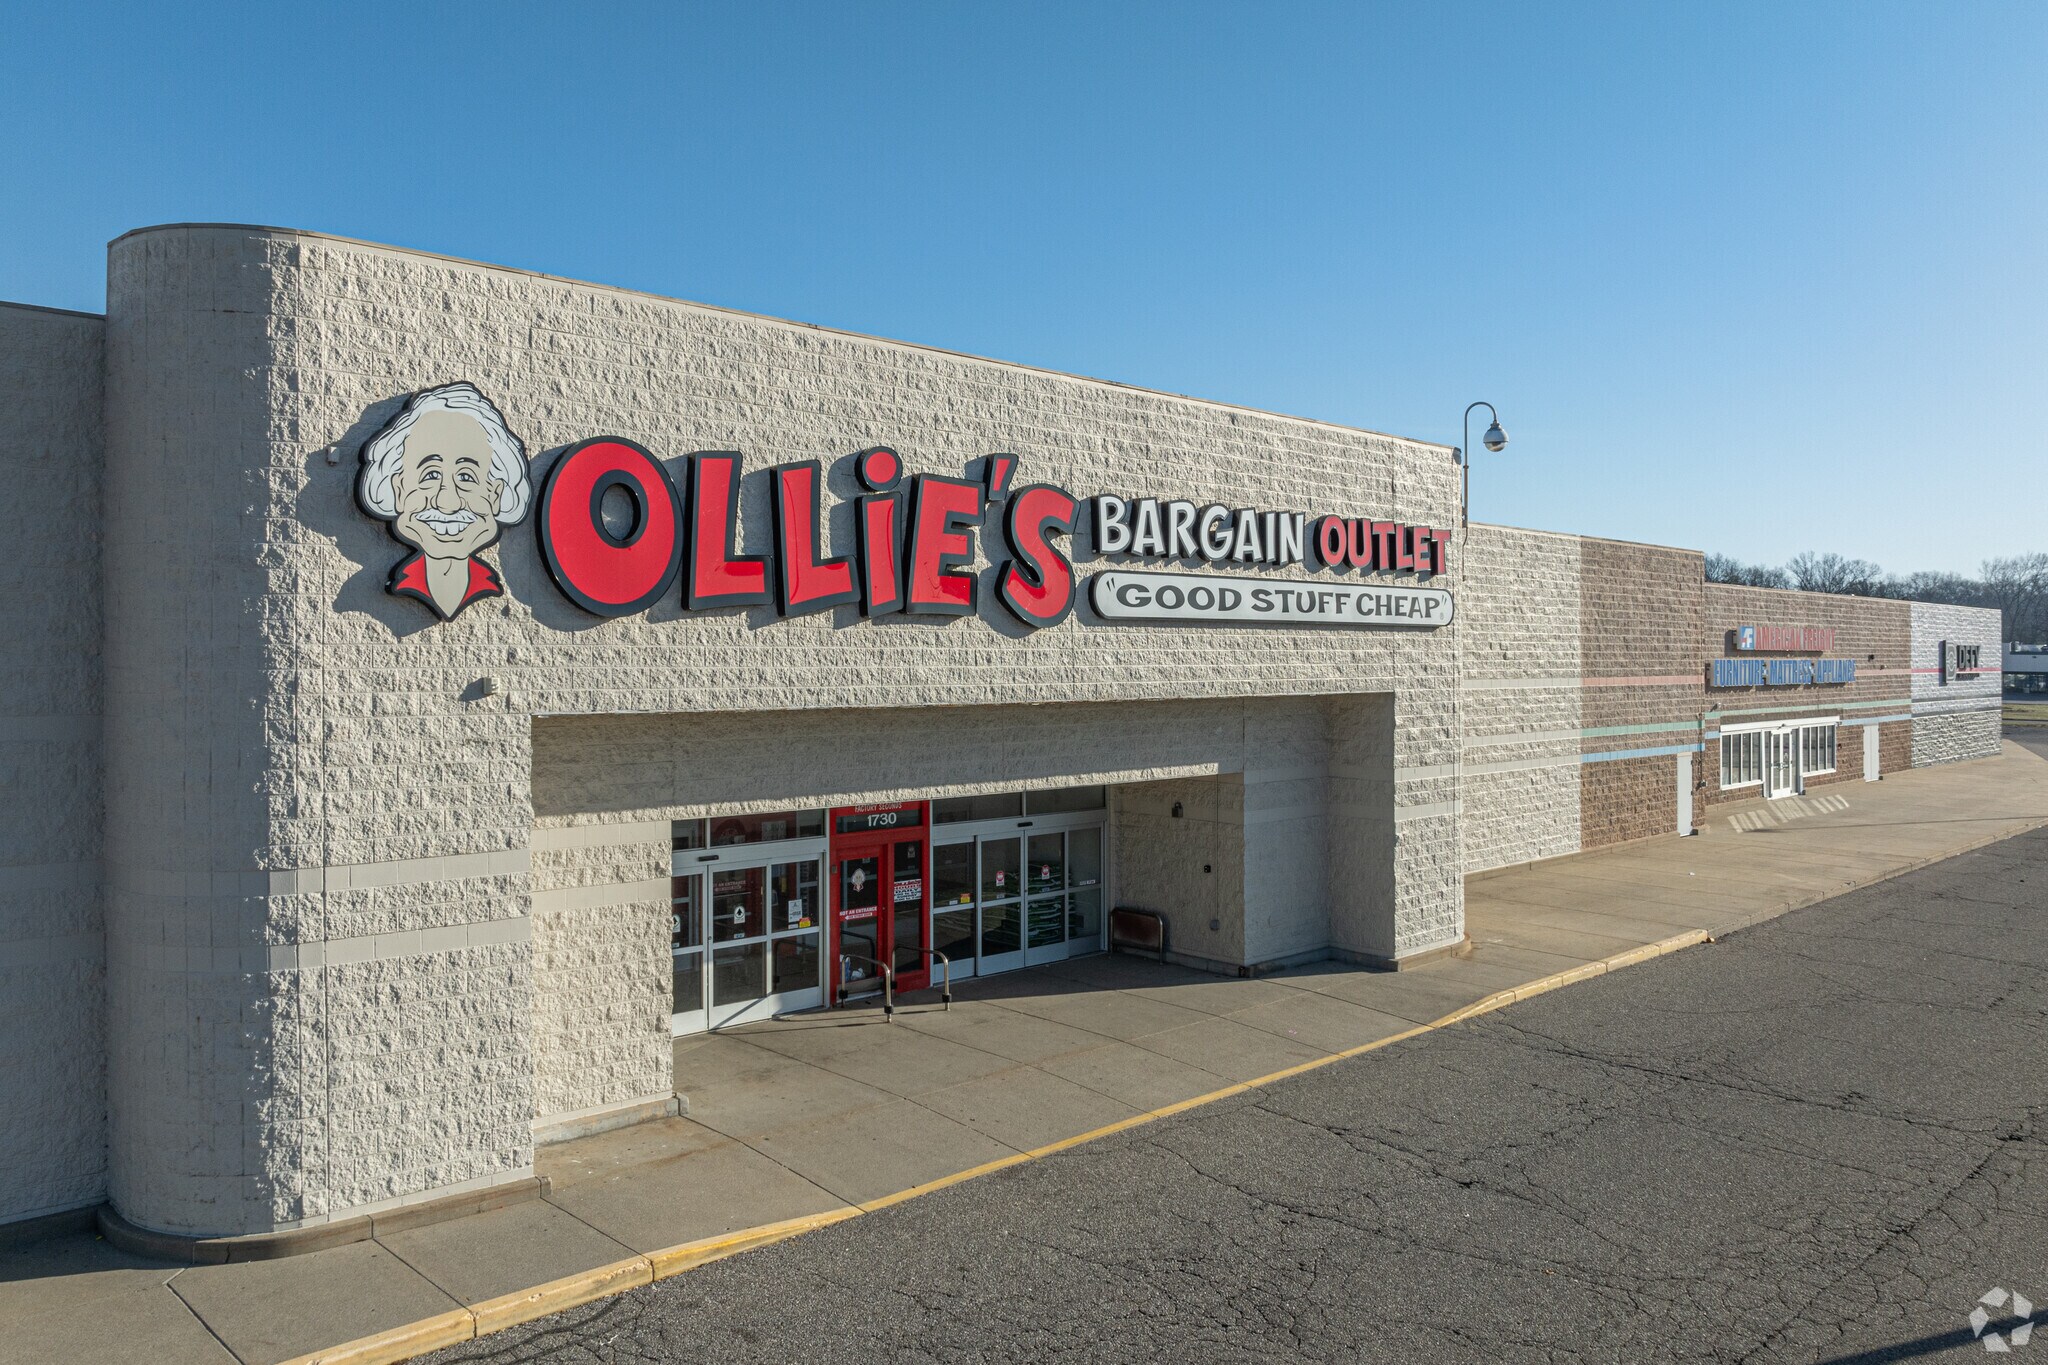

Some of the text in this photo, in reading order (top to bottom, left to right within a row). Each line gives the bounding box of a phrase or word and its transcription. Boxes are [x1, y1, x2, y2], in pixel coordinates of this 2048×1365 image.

[1093, 494, 1451, 576] BARGAIN OUTLET
[1251, 588, 1351, 614] STUFF
[1755, 626, 1800, 650] AMERICAN
[1803, 628, 1836, 650] FREIGHT
[1713, 659, 1856, 687] FURNITURE MATTRESS APPLIANCE
[867, 812, 897, 827] 1730
[856, 906, 878, 914] ENTRANCE
